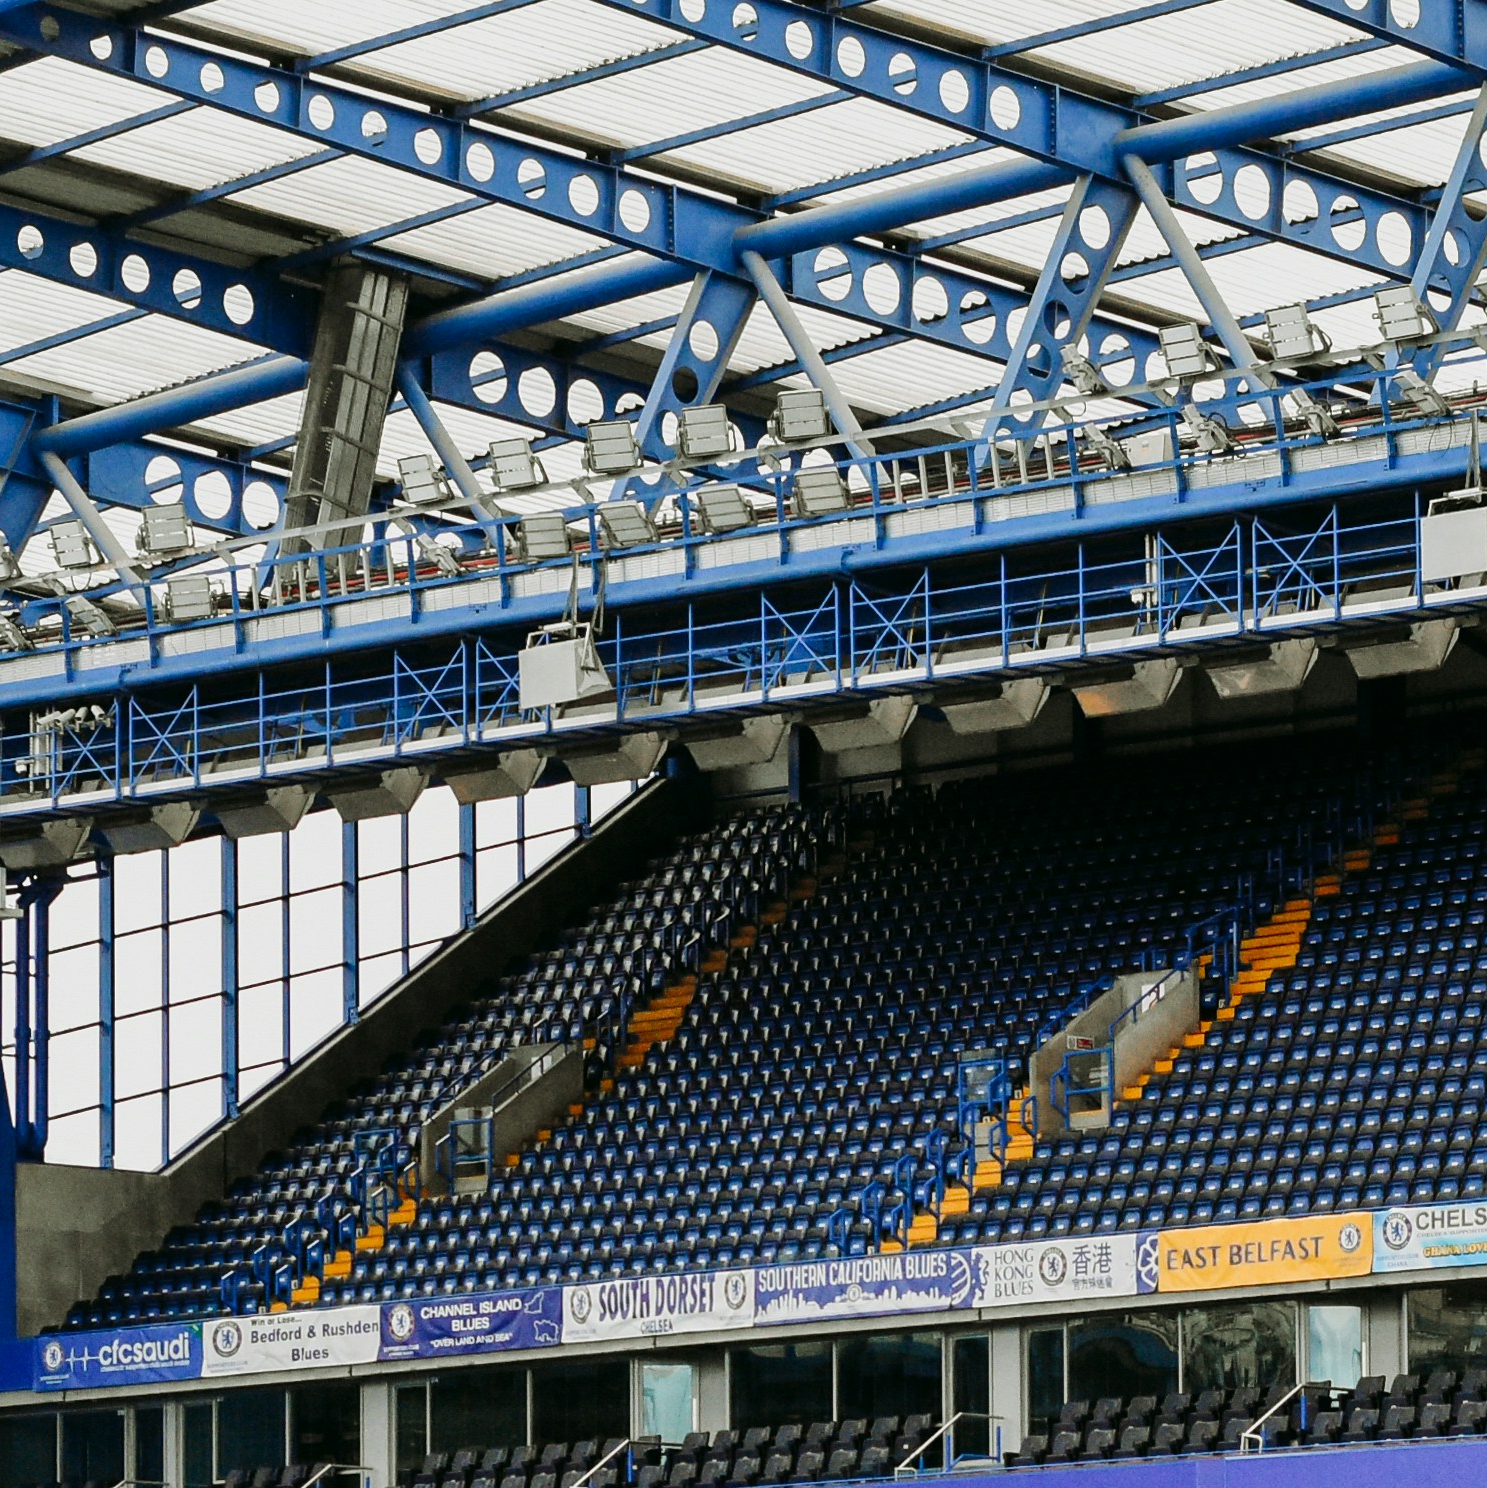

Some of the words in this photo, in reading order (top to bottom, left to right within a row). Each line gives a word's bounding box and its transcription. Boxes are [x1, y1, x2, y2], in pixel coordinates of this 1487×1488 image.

[995, 1248, 1033, 1265] HONG
[1072, 1242, 1111, 1276] 香港
[1167, 1246, 1220, 1270] EAST
[1229, 1236, 1324, 1265] BELFAST
[1424, 1245, 1461, 1257] GHANA
[759, 1266, 826, 1292] SOUTHERN
[829, 1256, 903, 1286] CALIFORNIA
[906, 1252, 946, 1278] BLUES
[995, 1265, 1033, 1281] KONG
[599, 1280, 649, 1321] SOUTH
[655, 1273, 715, 1316] DORSET
[995, 1281, 1033, 1298] BLUES
[421, 1303, 477, 1319] CHANNEL
[480, 1298, 521, 1314] ISLAND
[251, 1327, 301, 1343] Bedford
[307, 1326, 316, 1338] &
[322, 1320, 378, 1337] Rushden
[452, 1318, 490, 1331] BLUES
[640, 1319, 673, 1333] CHELSEA
[456, 1335, 475, 1345] LAND
[477, 1334, 494, 1344] AND
[99, 1332, 189, 1366] cfcsaudi
[292, 1348, 329, 1361] Blues
